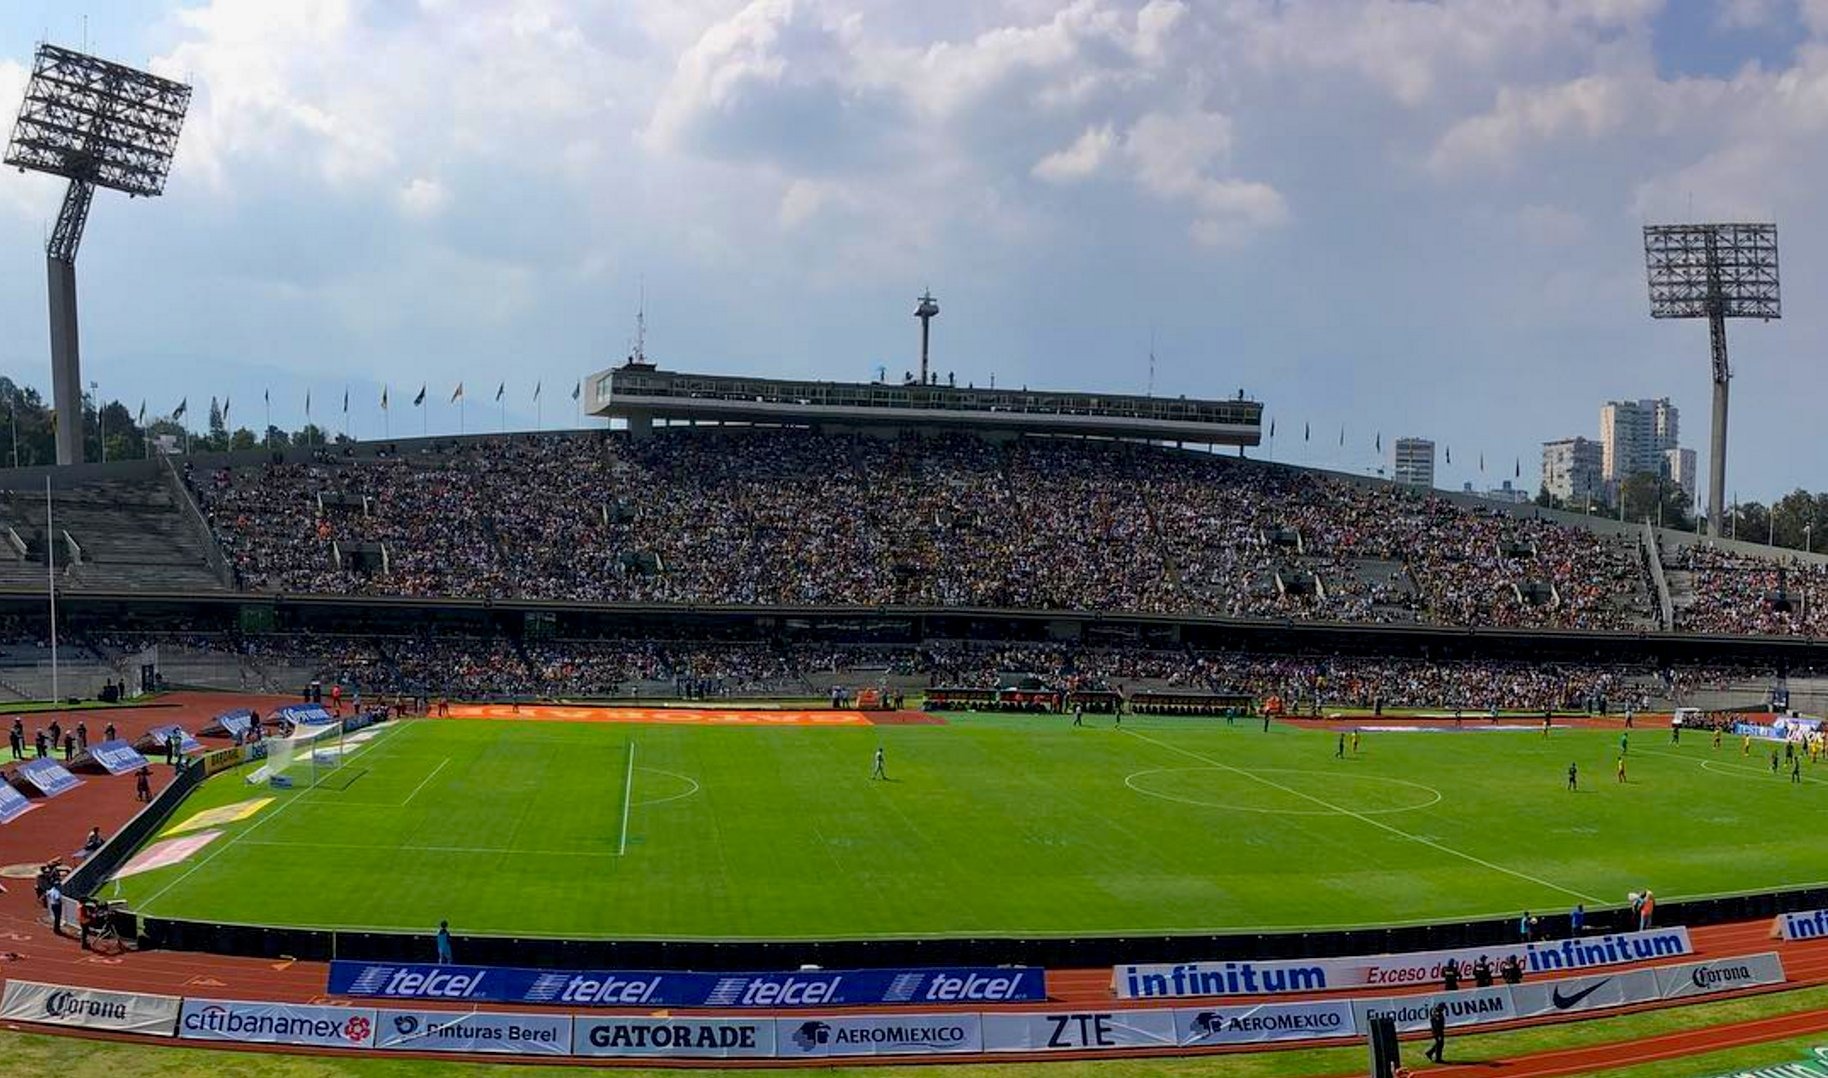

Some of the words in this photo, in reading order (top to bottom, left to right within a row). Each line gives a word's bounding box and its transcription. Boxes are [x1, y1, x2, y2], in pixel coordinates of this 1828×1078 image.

[1787, 910, 1828, 938] inf
[1527, 933, 1683, 970] infinitum
[385, 968, 486, 998] telcel
[561, 975, 662, 1002] telcel
[926, 973, 1023, 1000] telcel
[1128, 963, 1326, 997] infinitum
[1367, 966, 1426, 984] Exceso
[1692, 964, 1751, 989] Corona
[742, 976, 843, 1005] telcel
[46, 991, 126, 1019] Corona
[1451, 997, 1504, 1017] UNAM
[185, 1006, 343, 1038] citibanamex
[426, 1023, 502, 1040] Pinturas
[508, 1025, 557, 1042] Berel
[1047, 1014, 1115, 1048] ZTE
[1228, 1012, 1341, 1032] AEROMEXICO
[589, 1025, 756, 1049] GATORADE
